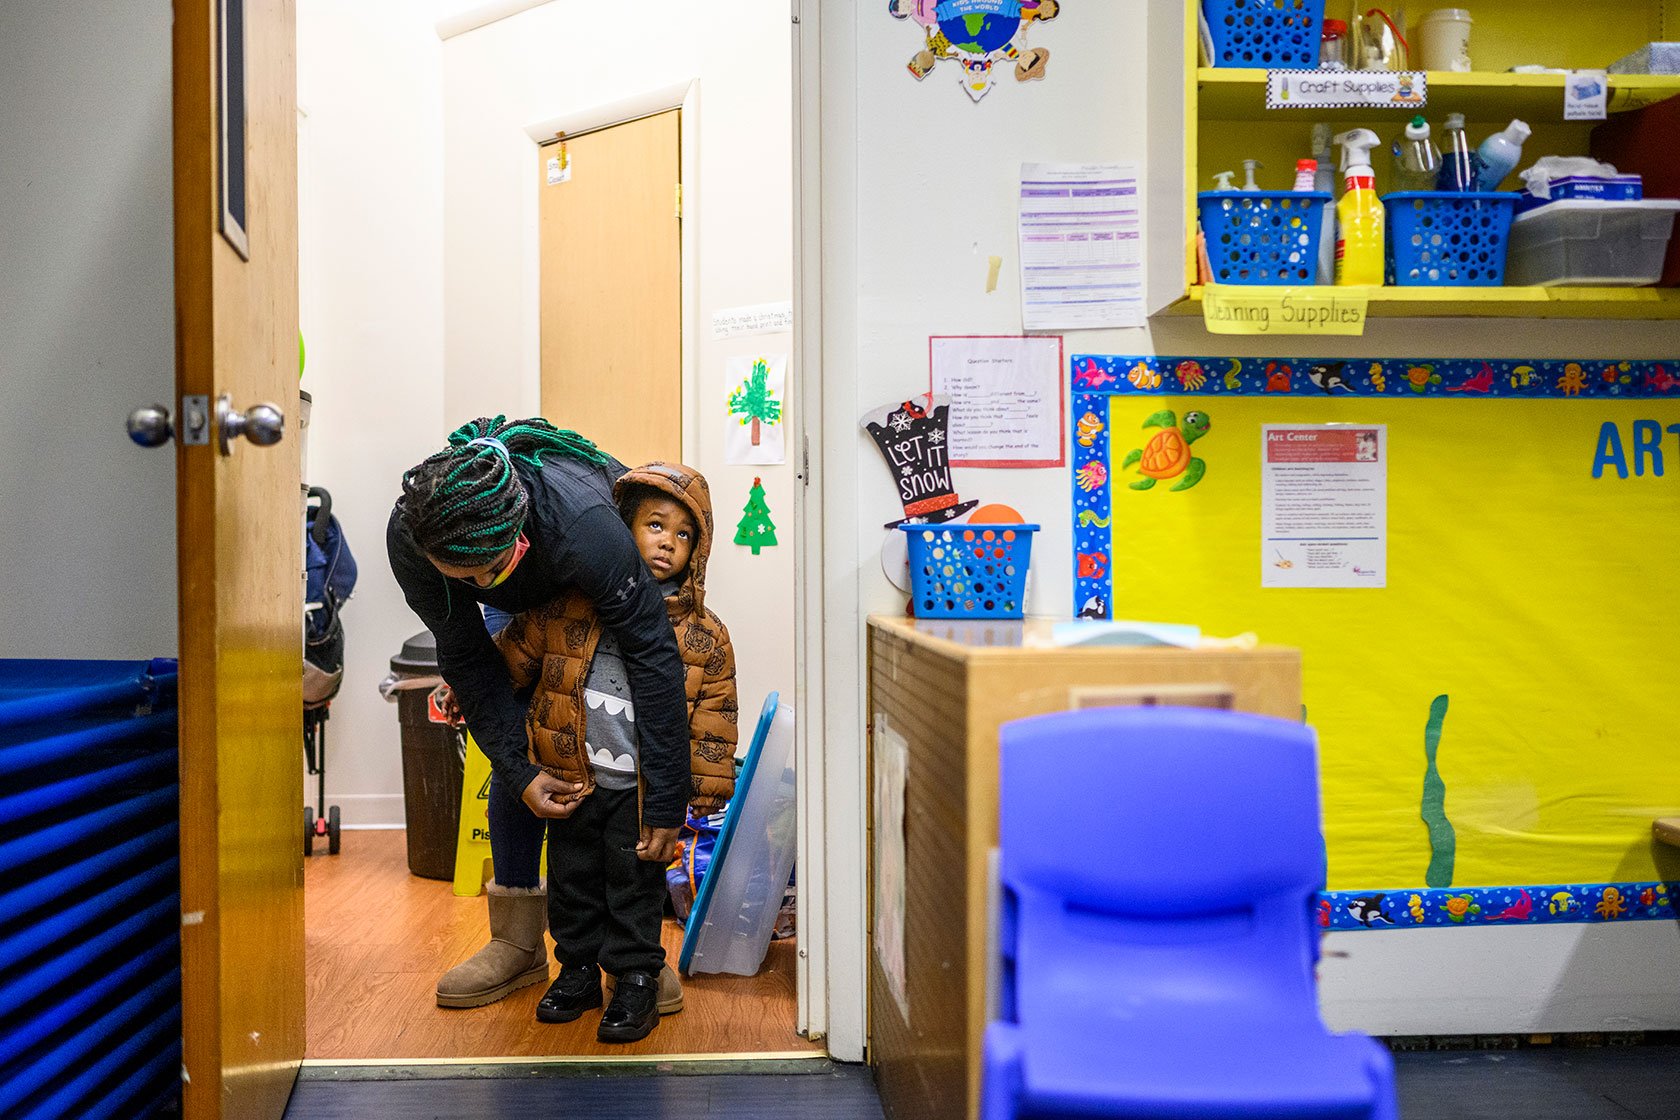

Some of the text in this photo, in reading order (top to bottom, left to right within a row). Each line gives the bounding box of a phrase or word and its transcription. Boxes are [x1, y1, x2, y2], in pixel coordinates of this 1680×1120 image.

[1300, 80, 1395, 96] Craft Supplies
[1282, 296, 1360, 328] Supplies
[1268, 432, 1318, 441] Art Center
[927, 446, 945, 468] IT
[472, 828, 490, 840] Pis
